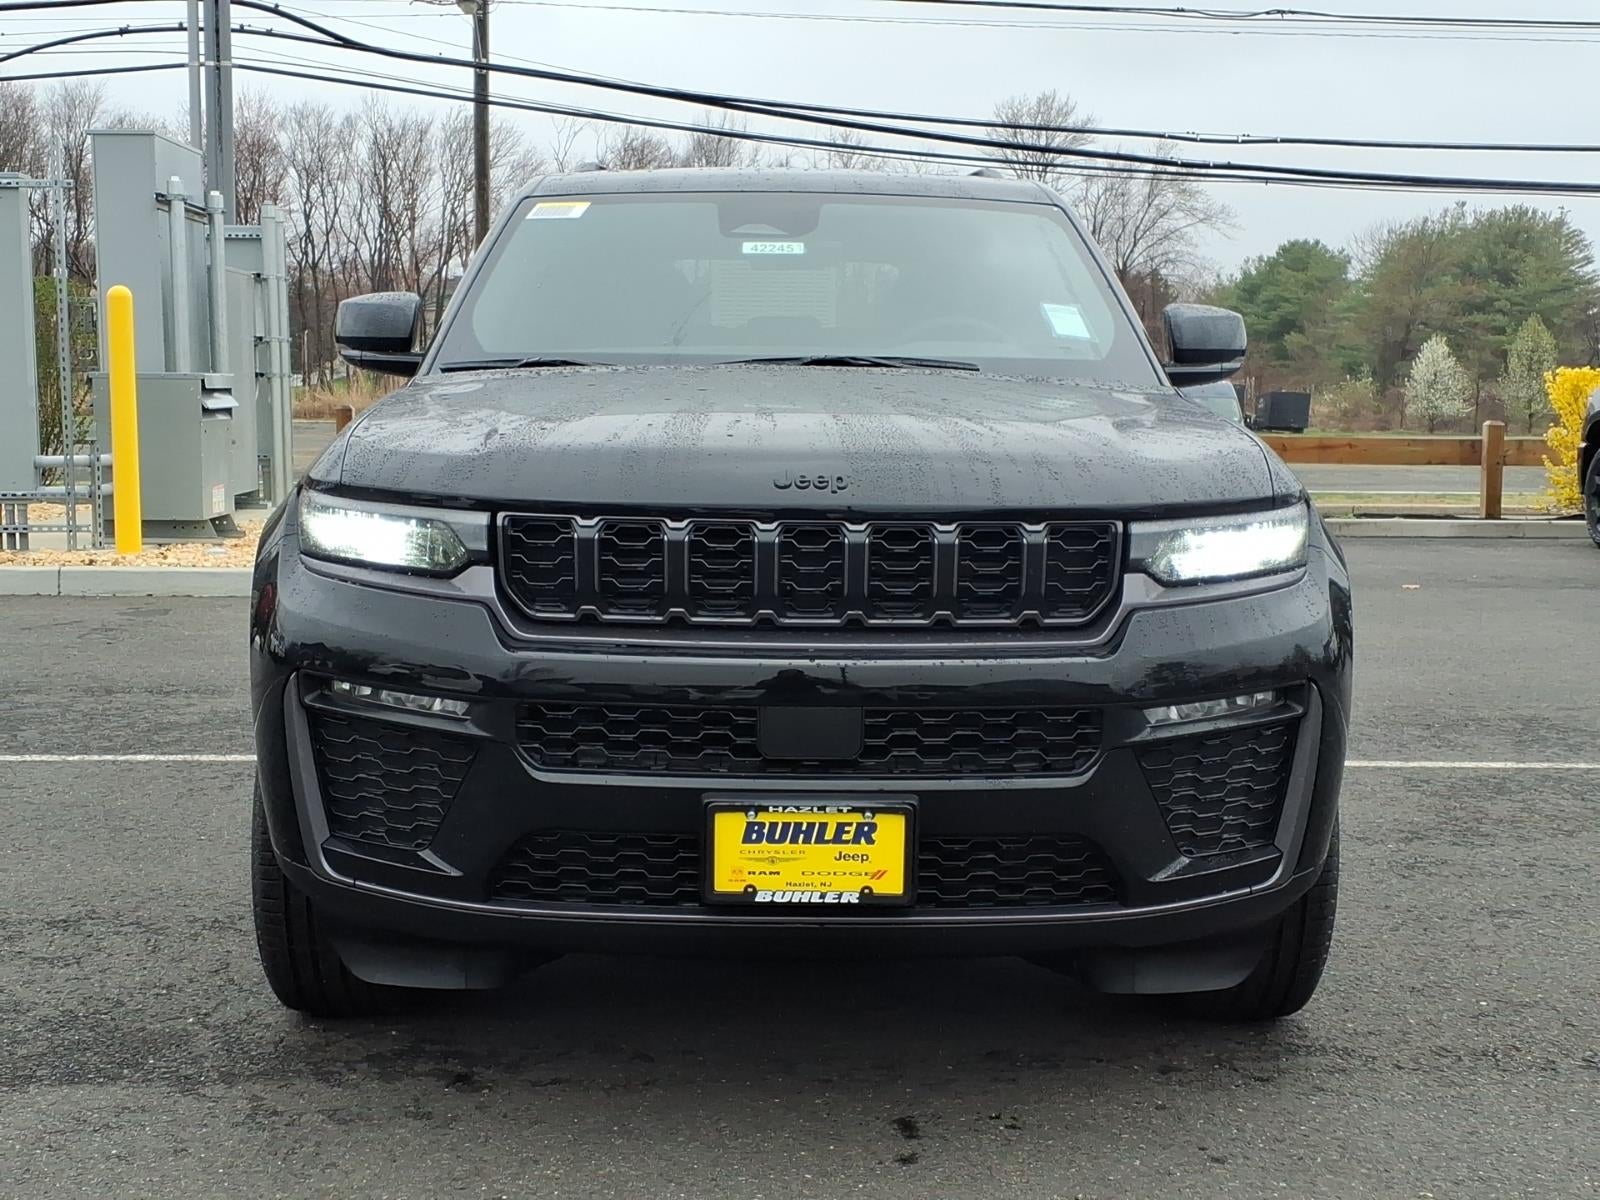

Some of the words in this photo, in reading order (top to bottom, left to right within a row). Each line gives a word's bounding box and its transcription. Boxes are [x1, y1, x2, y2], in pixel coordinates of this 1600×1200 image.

[750, 244, 795, 253] 42245
[773, 469, 849, 494] Jeep
[768, 806, 853, 814] HAZLET
[741, 821, 878, 845] BUHLER
[834, 851, 870, 863] Jeep
[755, 890, 860, 904] BUHLER
